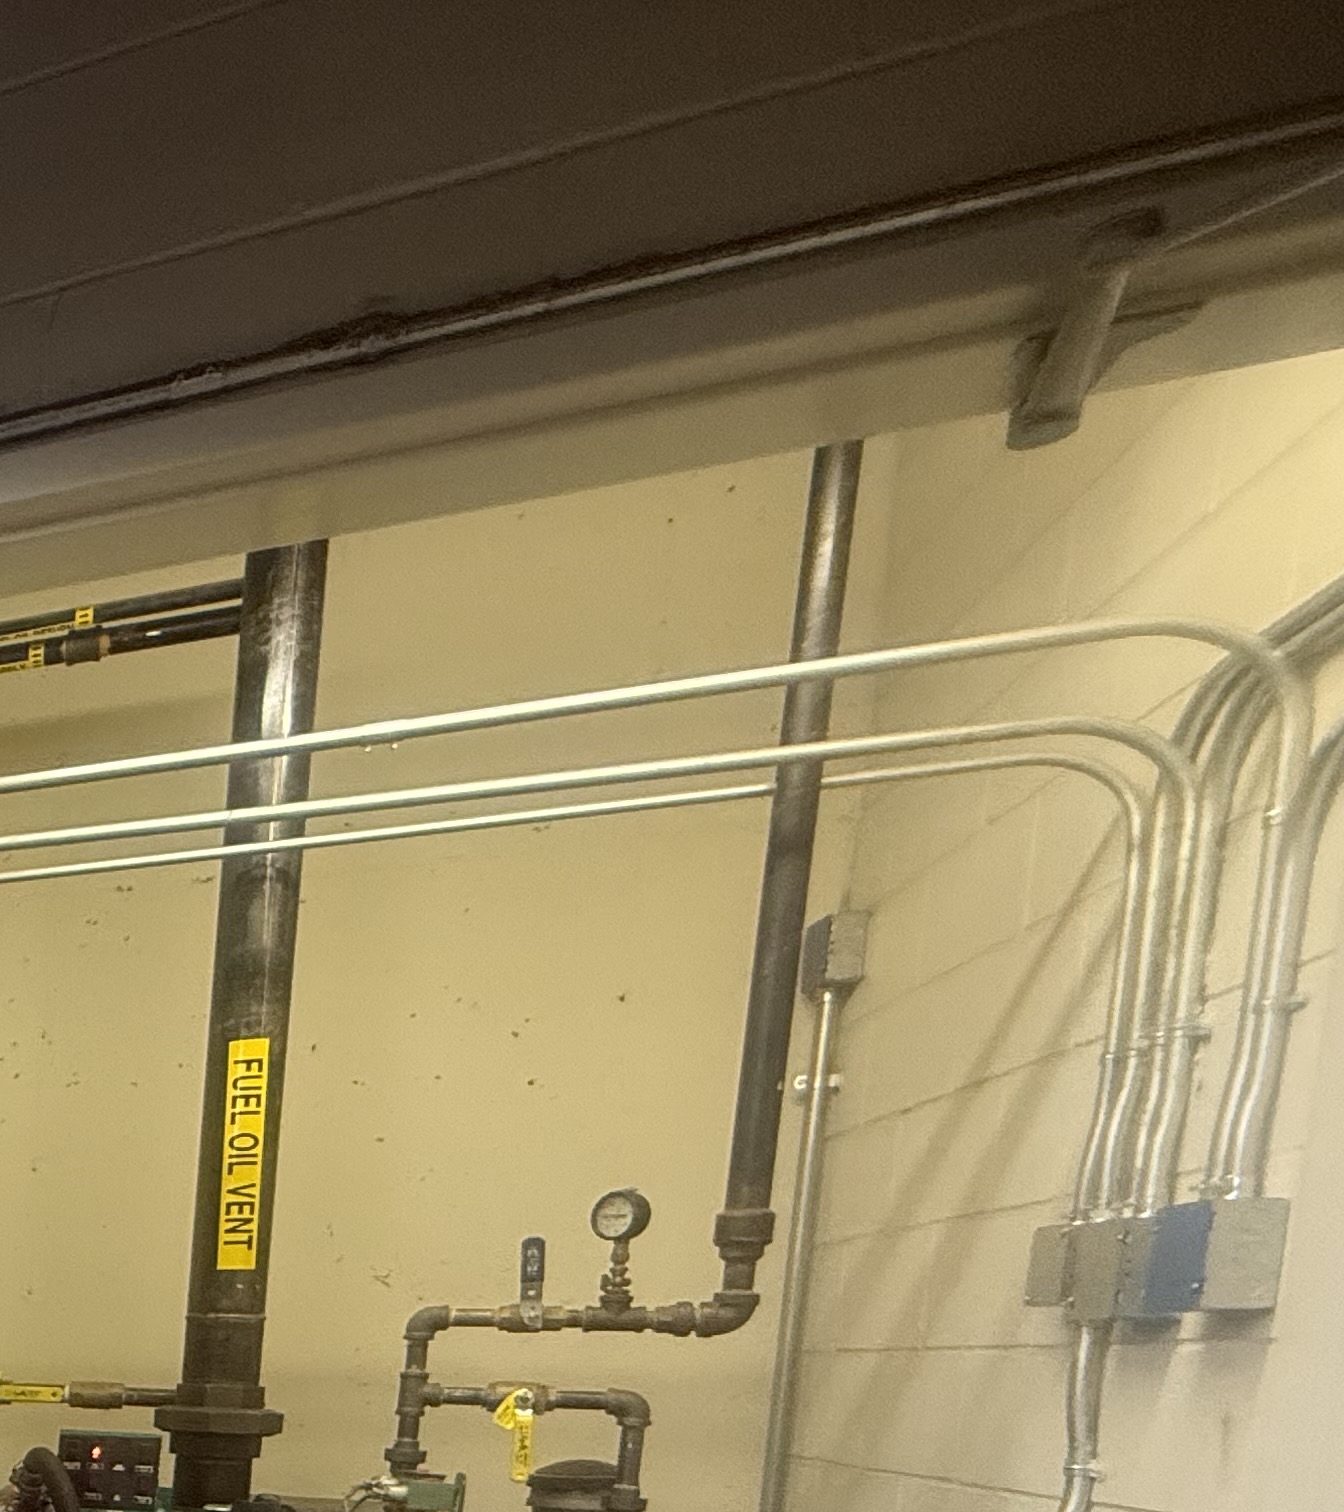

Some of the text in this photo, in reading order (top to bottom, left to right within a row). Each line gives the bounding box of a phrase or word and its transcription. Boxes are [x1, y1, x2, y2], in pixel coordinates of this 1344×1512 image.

[223, 1057, 264, 1251] FUEL OIL VENT
